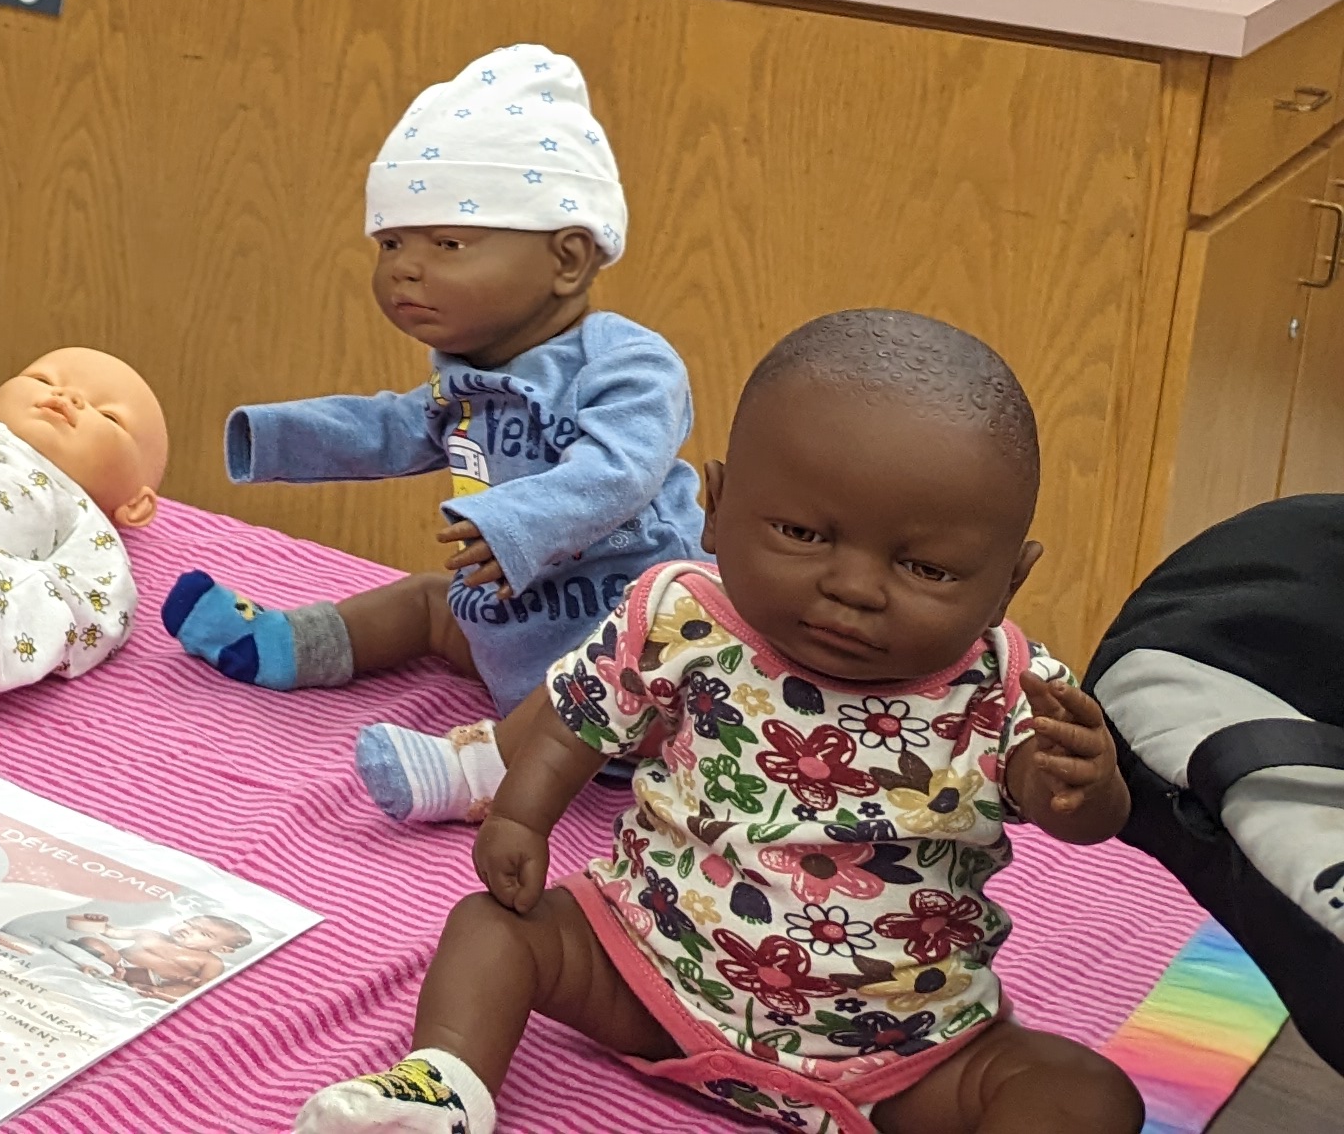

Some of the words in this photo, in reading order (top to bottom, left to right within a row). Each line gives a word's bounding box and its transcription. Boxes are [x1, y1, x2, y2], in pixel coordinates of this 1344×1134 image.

[1, 826, 202, 912] DEVELOPMENT
[16, 997, 38, 1011] AN
[41, 1009, 99, 1043] INFANT
